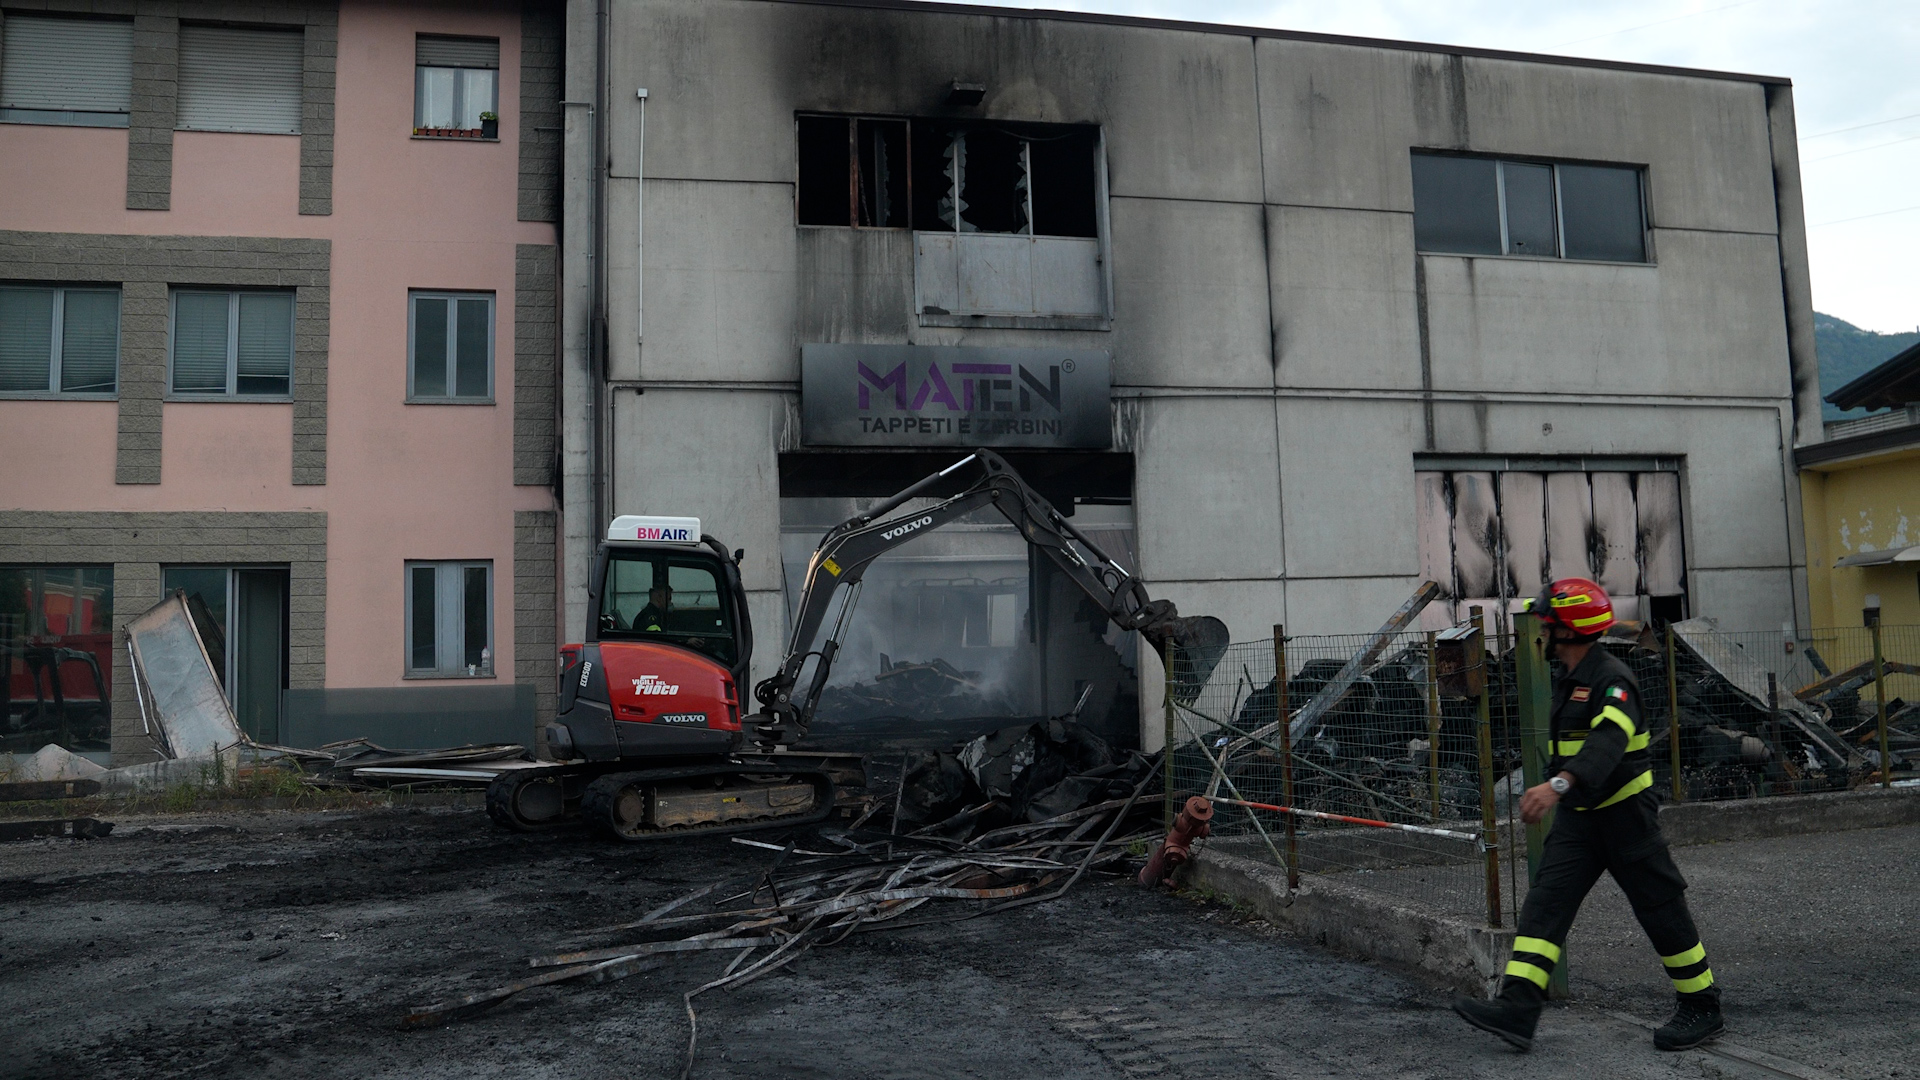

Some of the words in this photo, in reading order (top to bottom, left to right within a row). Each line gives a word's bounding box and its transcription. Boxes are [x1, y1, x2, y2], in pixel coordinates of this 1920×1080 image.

[858, 360, 1061, 412] MATEN
[859, 417, 950, 434] TAPPETI
[958, 418, 971, 434] E
[977, 418, 1062, 436] ZERBINI
[637, 527, 689, 540] BMAIR
[881, 515, 933, 540] VOLVO
[663, 714, 705, 723] VOLVO
